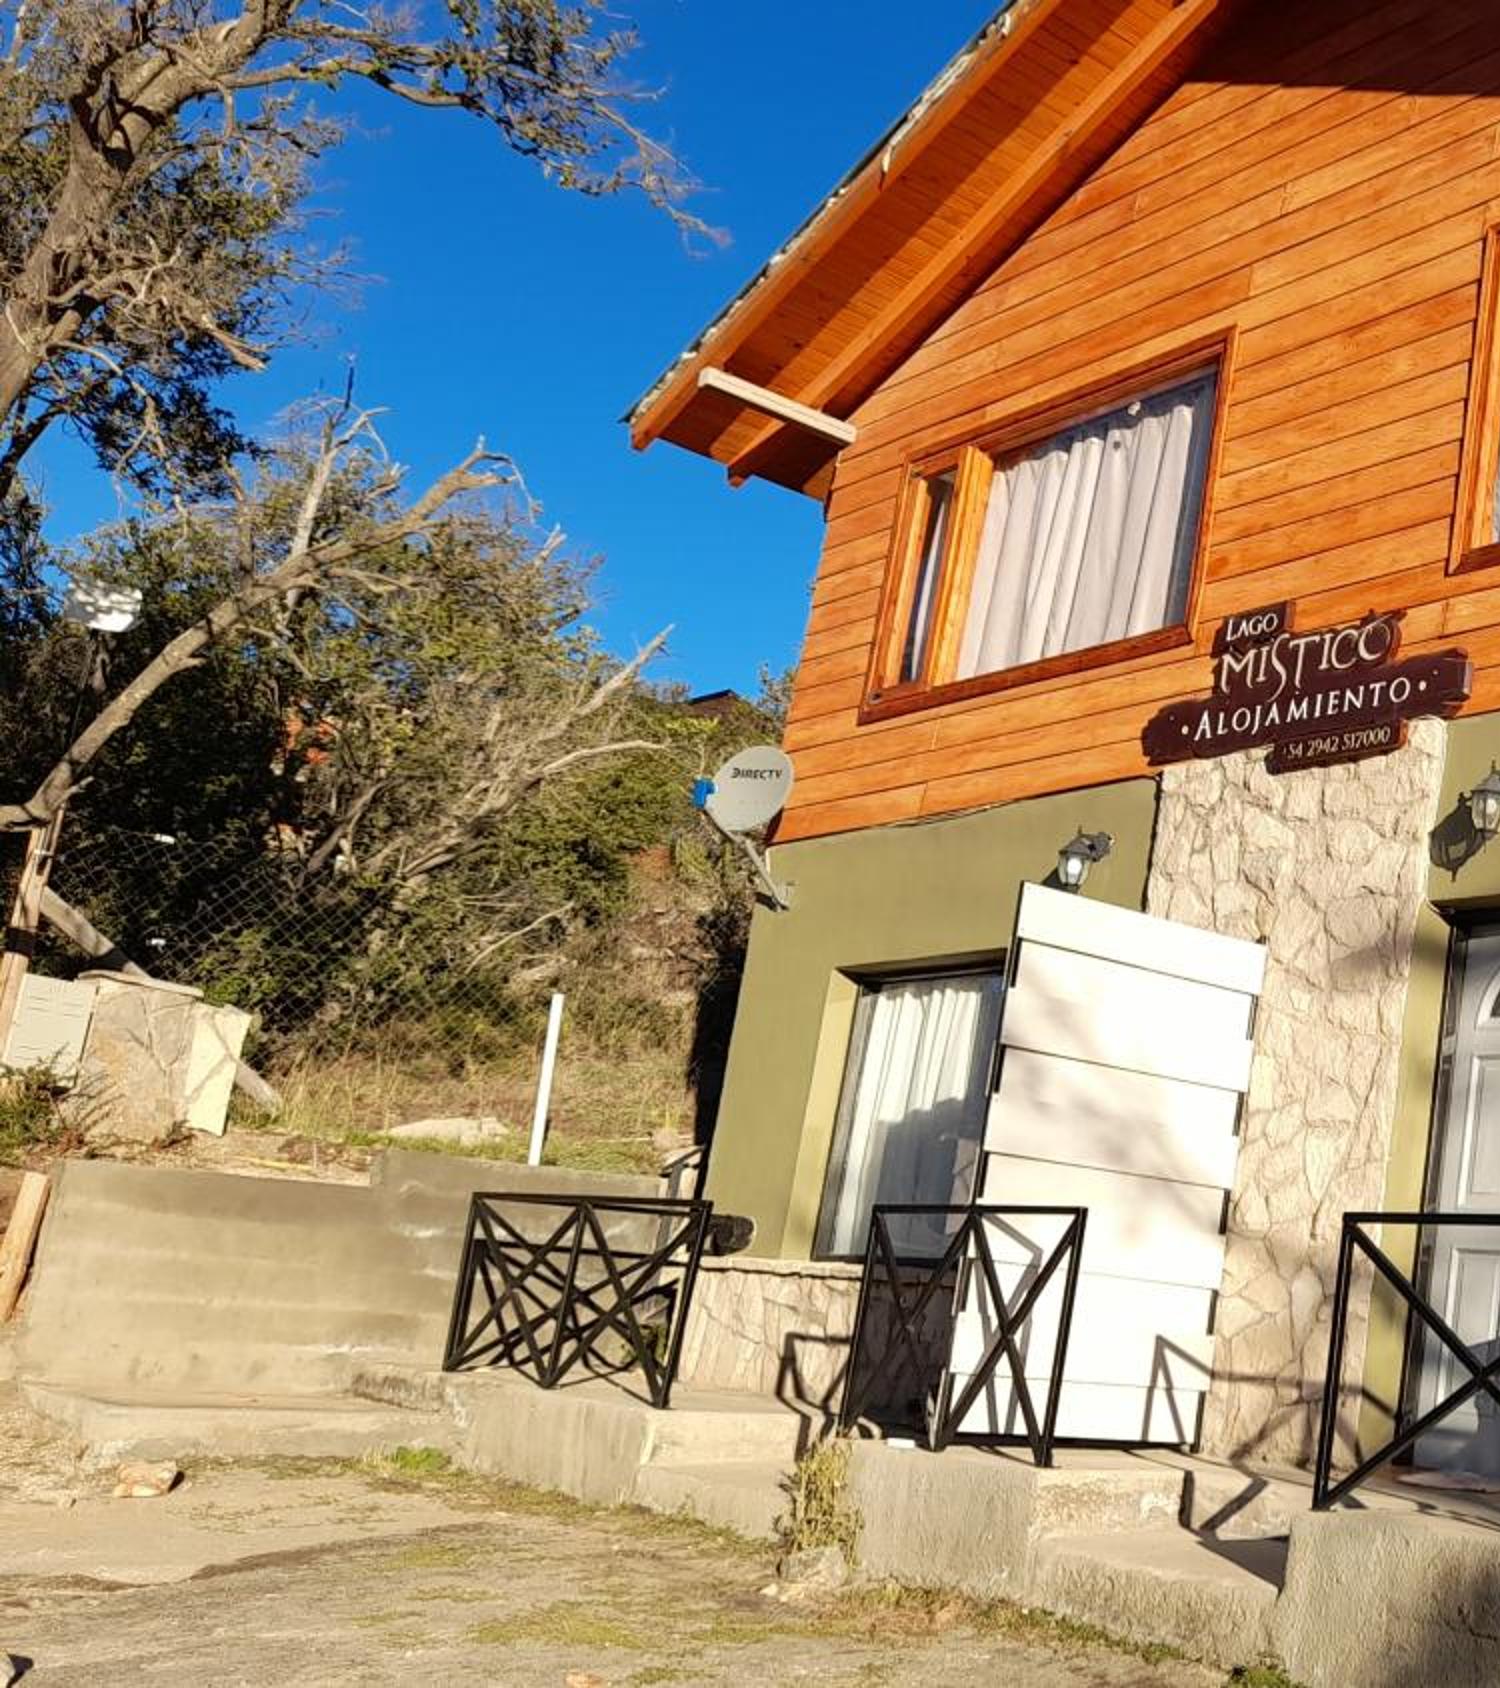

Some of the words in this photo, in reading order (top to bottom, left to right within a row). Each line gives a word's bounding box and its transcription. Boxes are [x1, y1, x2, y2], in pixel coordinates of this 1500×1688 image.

[1226, 613, 1278, 641] LAGO
[1194, 677, 1411, 740] ALOJAMIENTO
[1307, 735, 1340, 757] 2942
[1341, 726, 1391, 751] 517000
[731, 767, 783, 780] DIRECTV
